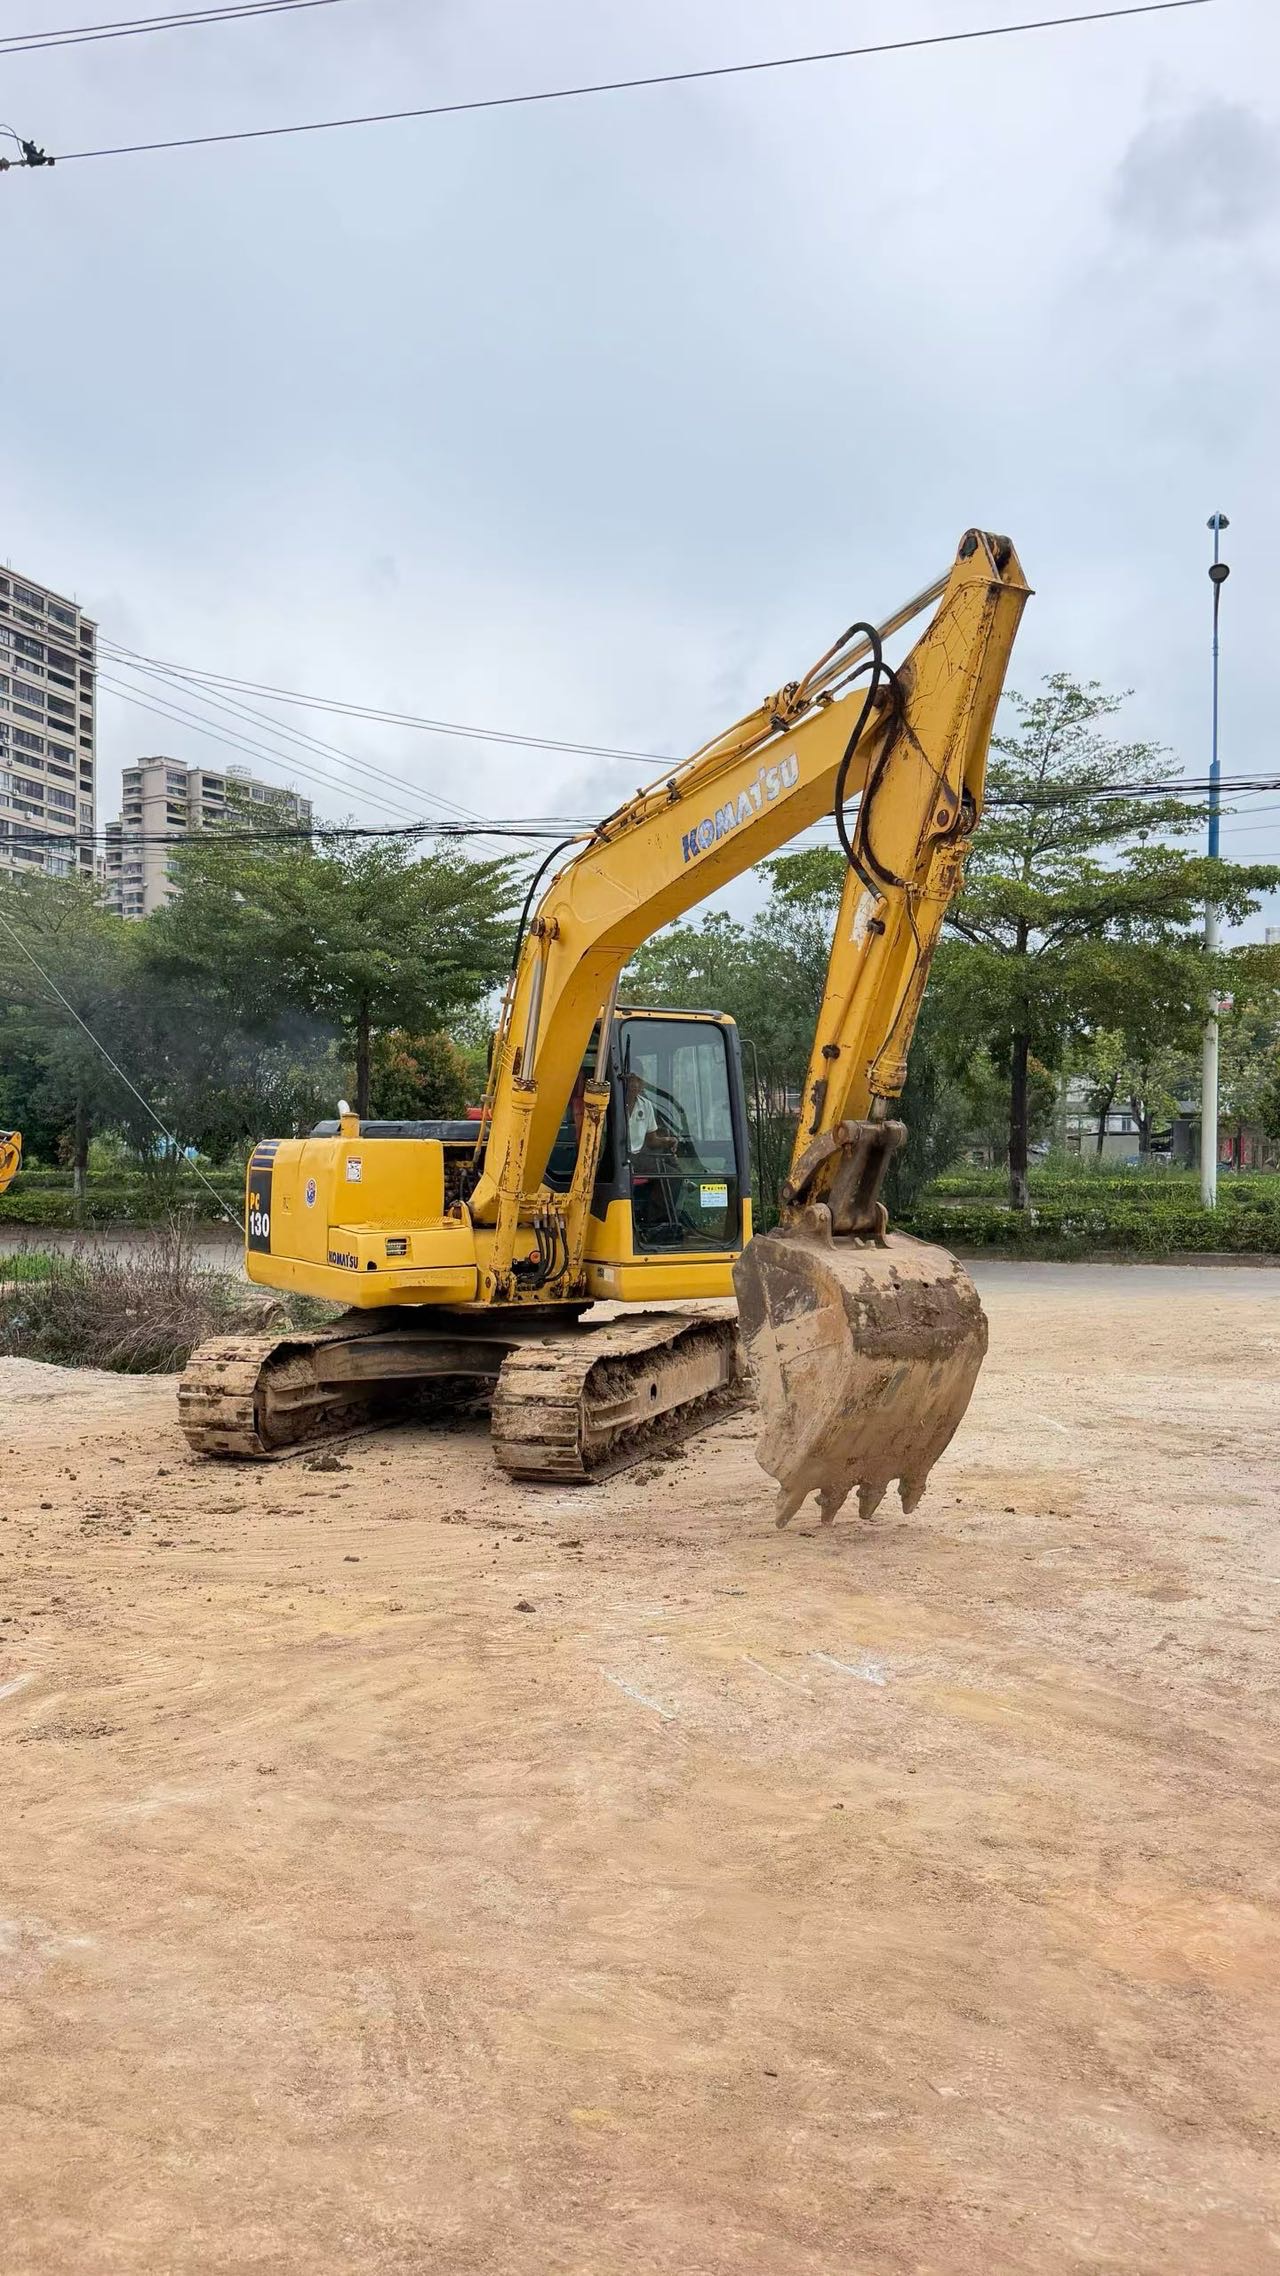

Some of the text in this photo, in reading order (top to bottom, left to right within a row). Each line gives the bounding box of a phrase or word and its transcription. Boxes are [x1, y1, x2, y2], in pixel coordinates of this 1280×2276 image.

[681, 752, 800, 864] KOMATSU
[250, 1192, 260, 1210] PC
[250, 1211, 270, 1238] 130
[328, 1250, 359, 1269] KOMATSU
